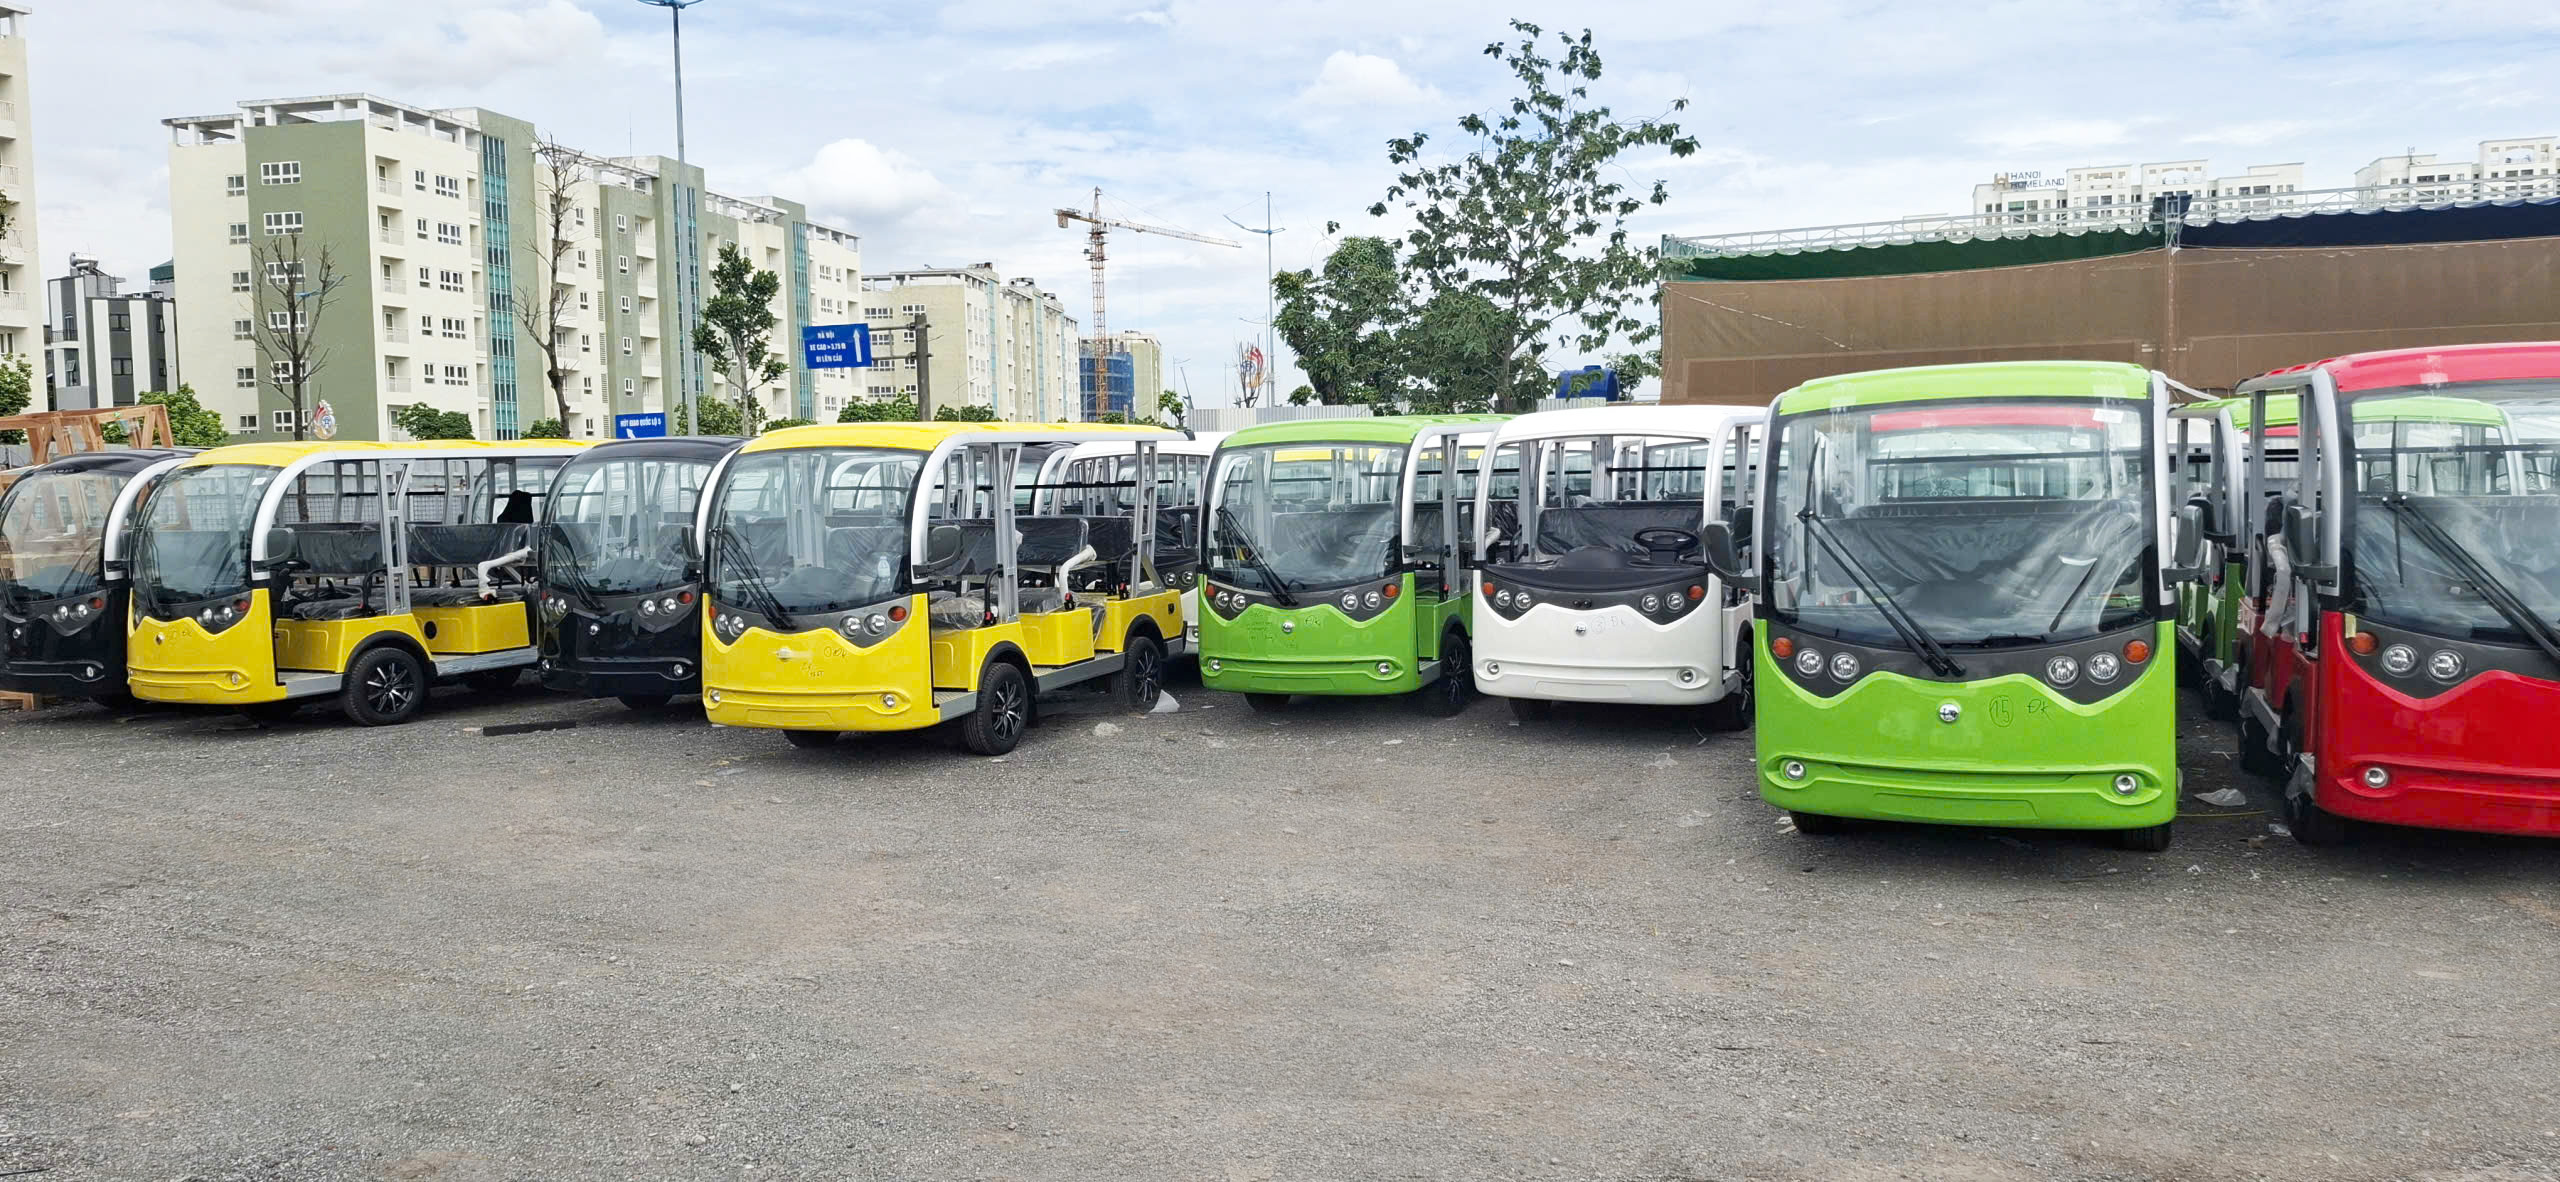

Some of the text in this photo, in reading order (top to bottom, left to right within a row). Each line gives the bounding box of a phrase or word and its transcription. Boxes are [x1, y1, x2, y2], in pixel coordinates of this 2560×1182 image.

[2010, 171, 2041, 180] HANOI
[2010, 178, 2065, 189] HOMELAND
[1989, 698, 2011, 724] 15
